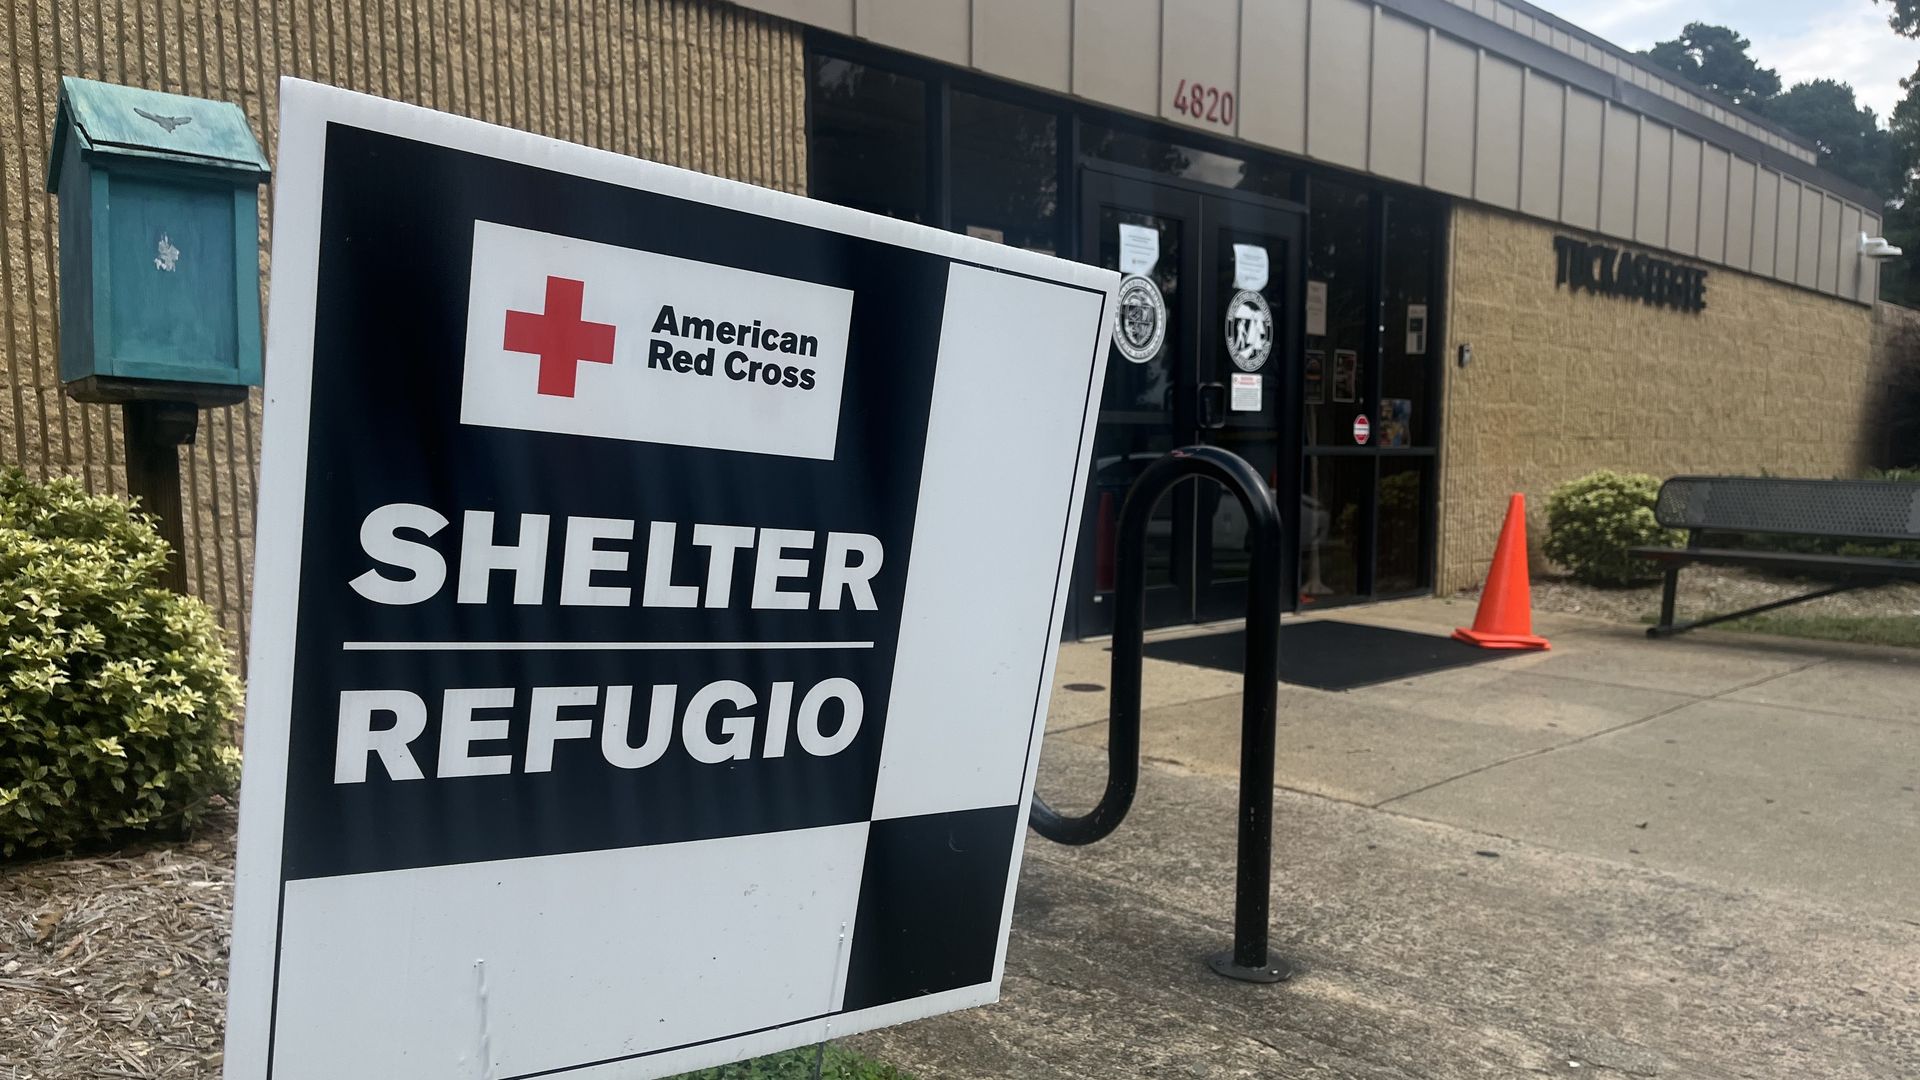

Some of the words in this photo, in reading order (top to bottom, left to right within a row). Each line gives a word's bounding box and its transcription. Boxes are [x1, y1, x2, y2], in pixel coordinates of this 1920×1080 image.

[1174, 79, 1234, 126] 4820
[651, 304, 818, 358] American
[647, 338, 716, 377] Red
[724, 350, 817, 391] Cross
[348, 502, 885, 611] SHELTER
[333, 676, 864, 784] REFUGIO
